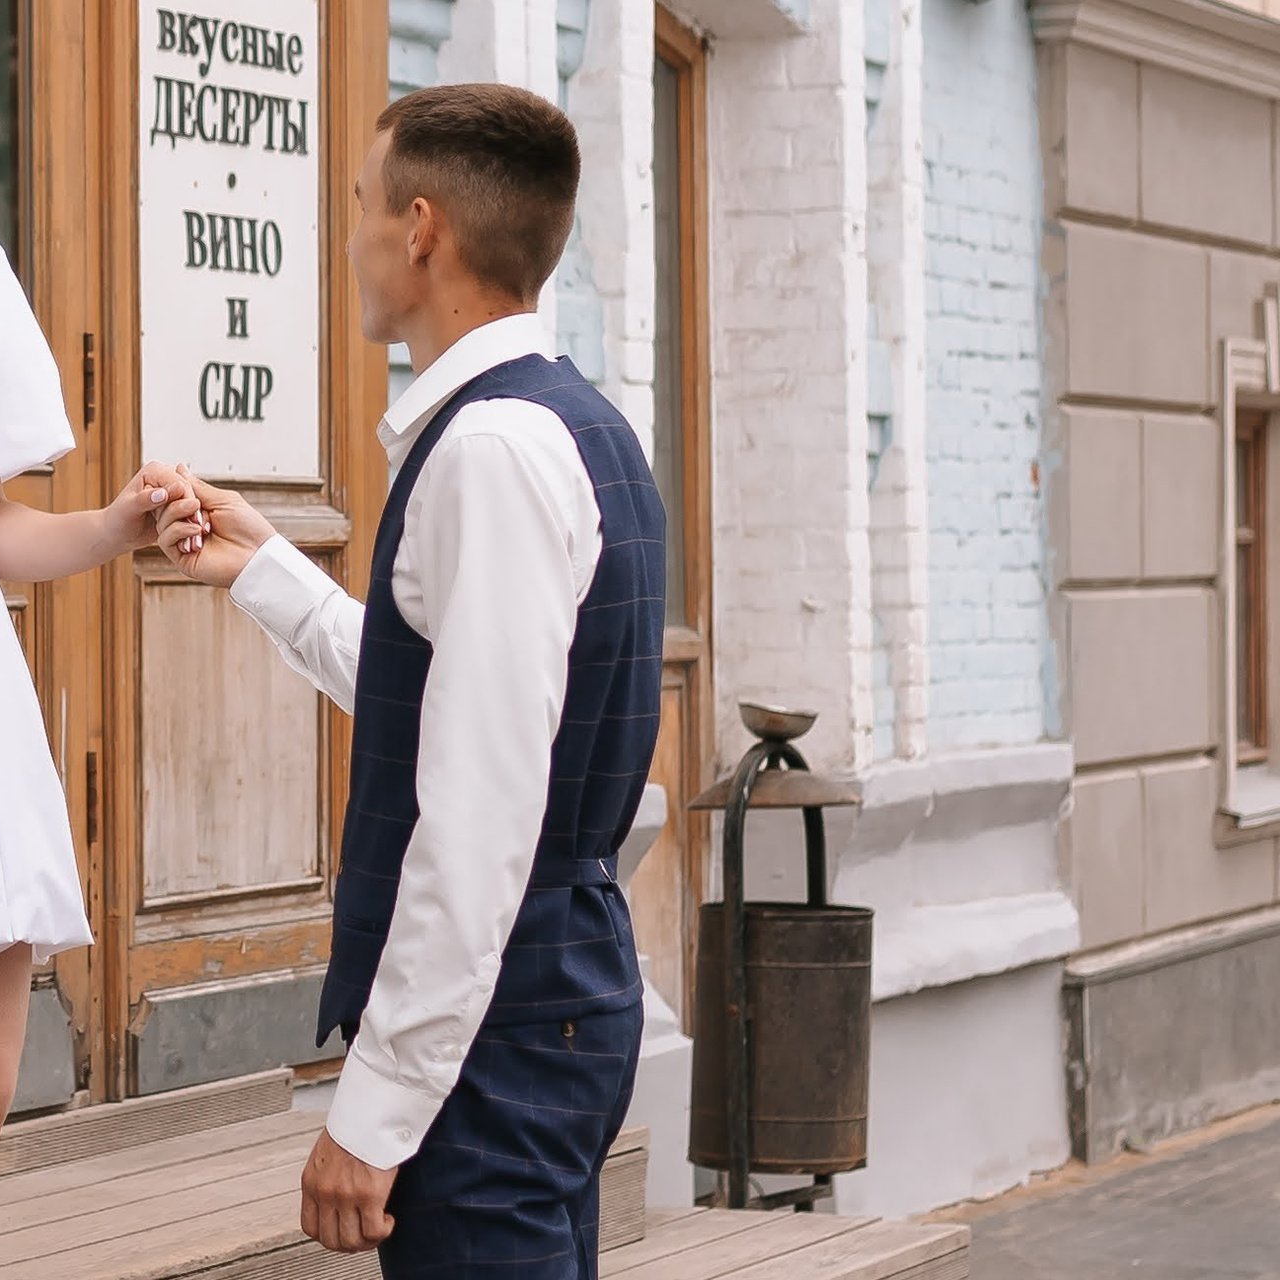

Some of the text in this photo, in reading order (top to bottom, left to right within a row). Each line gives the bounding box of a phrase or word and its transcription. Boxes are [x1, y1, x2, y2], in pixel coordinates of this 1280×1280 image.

[150, 75, 309, 157] ДЕСЕРТЫ
[183, 210, 283, 278] ВИНО
[198, 360, 274, 423] СЫР
